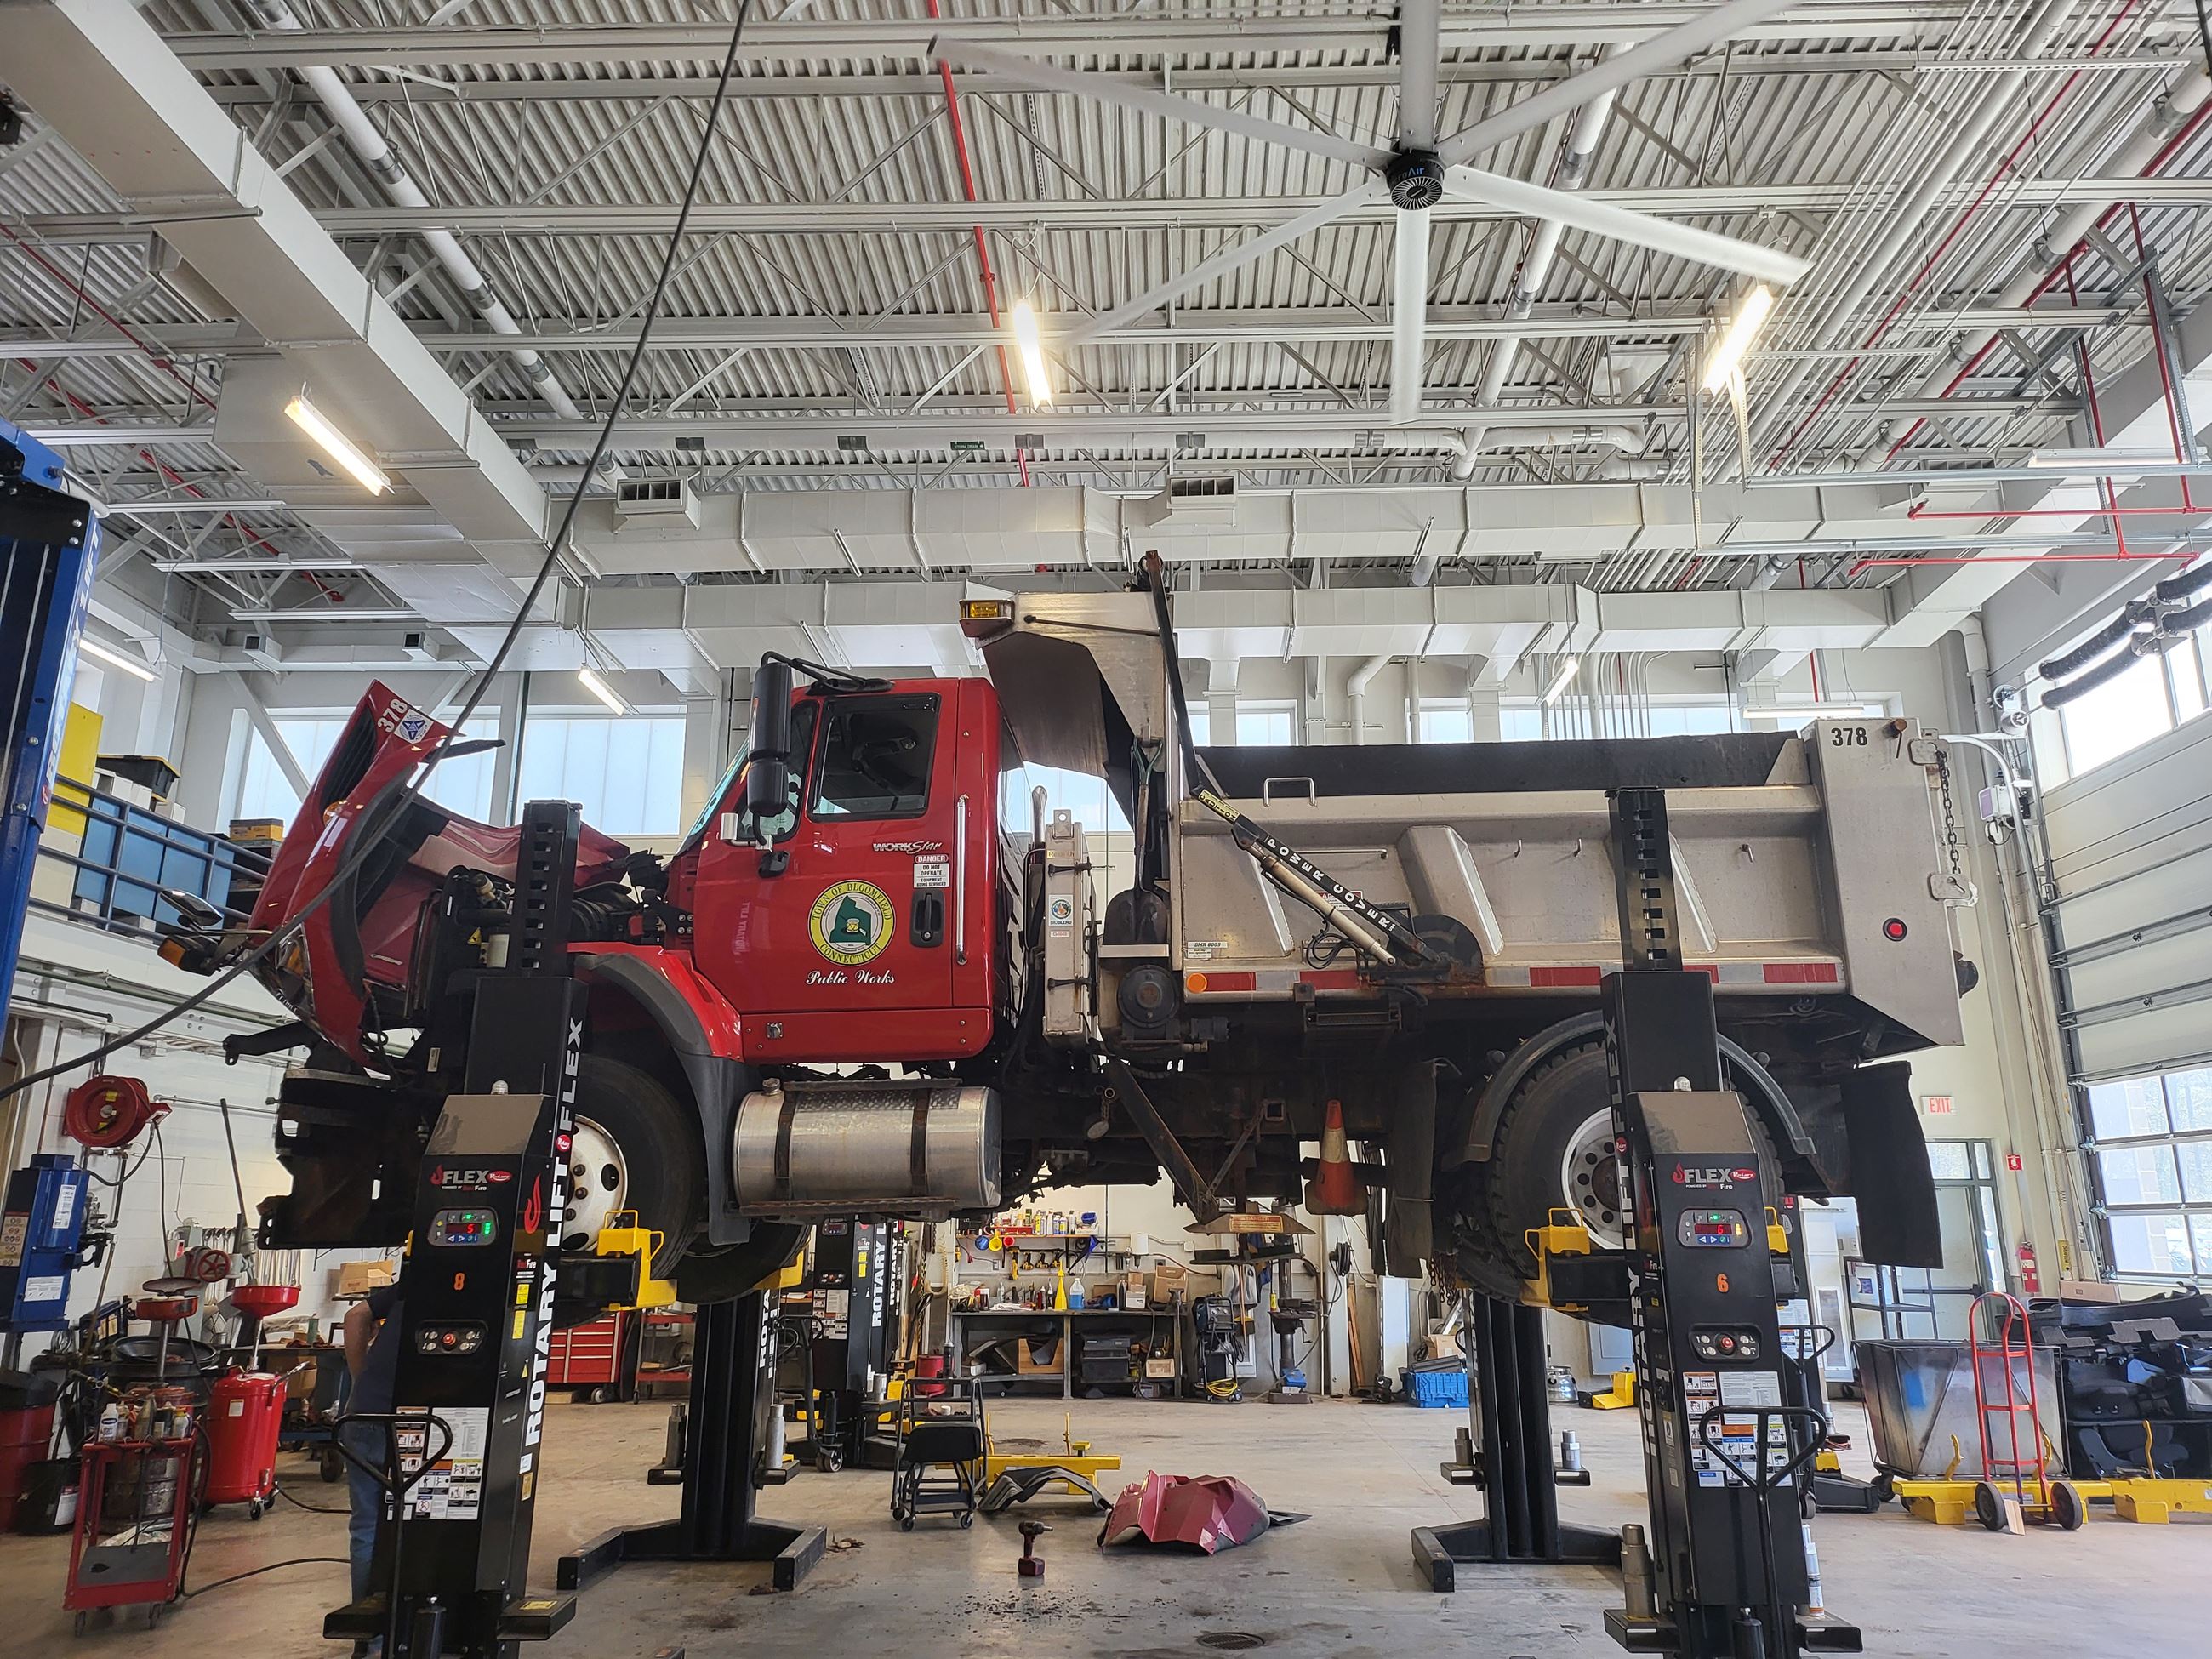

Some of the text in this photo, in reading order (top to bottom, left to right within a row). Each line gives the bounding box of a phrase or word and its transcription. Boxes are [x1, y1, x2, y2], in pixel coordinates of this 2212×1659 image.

[79, 522, 100, 613] LIFT
[378, 698, 408, 733] 378
[1831, 727, 1868, 747] 378
[1199, 794, 1237, 822] CAUTION
[1267, 837, 1325, 881] POWER
[1332, 883, 1391, 930] COVER
[812, 894, 831, 921] TOWN
[831, 885, 843, 897] OF
[847, 883, 892, 921] BLOOMFIELD
[819, 943, 883, 964] CONNECTICUT
[806, 969, 895, 985] Public Works
[559, 1017, 584, 1132] FLEX
[1605, 1016, 1625, 1133] FLEX
[1929, 1097, 1951, 1113] EXIT
[442, 1170, 490, 1184] FLEX
[1685, 1168, 1733, 1183] FLEX
[1617, 1158, 1637, 1250] LIFT
[466, 1224, 475, 1234] 5
[1717, 1224, 1724, 1234] 6
[453, 1272, 466, 1291] 8
[872, 1240, 887, 1327] ROTARY
[890, 1238, 898, 1305] ROTARY
[1716, 1274, 1729, 1293] 6
[525, 1156, 568, 1446] ROTARY LIFT
[759, 1289, 771, 1369] ROTA
